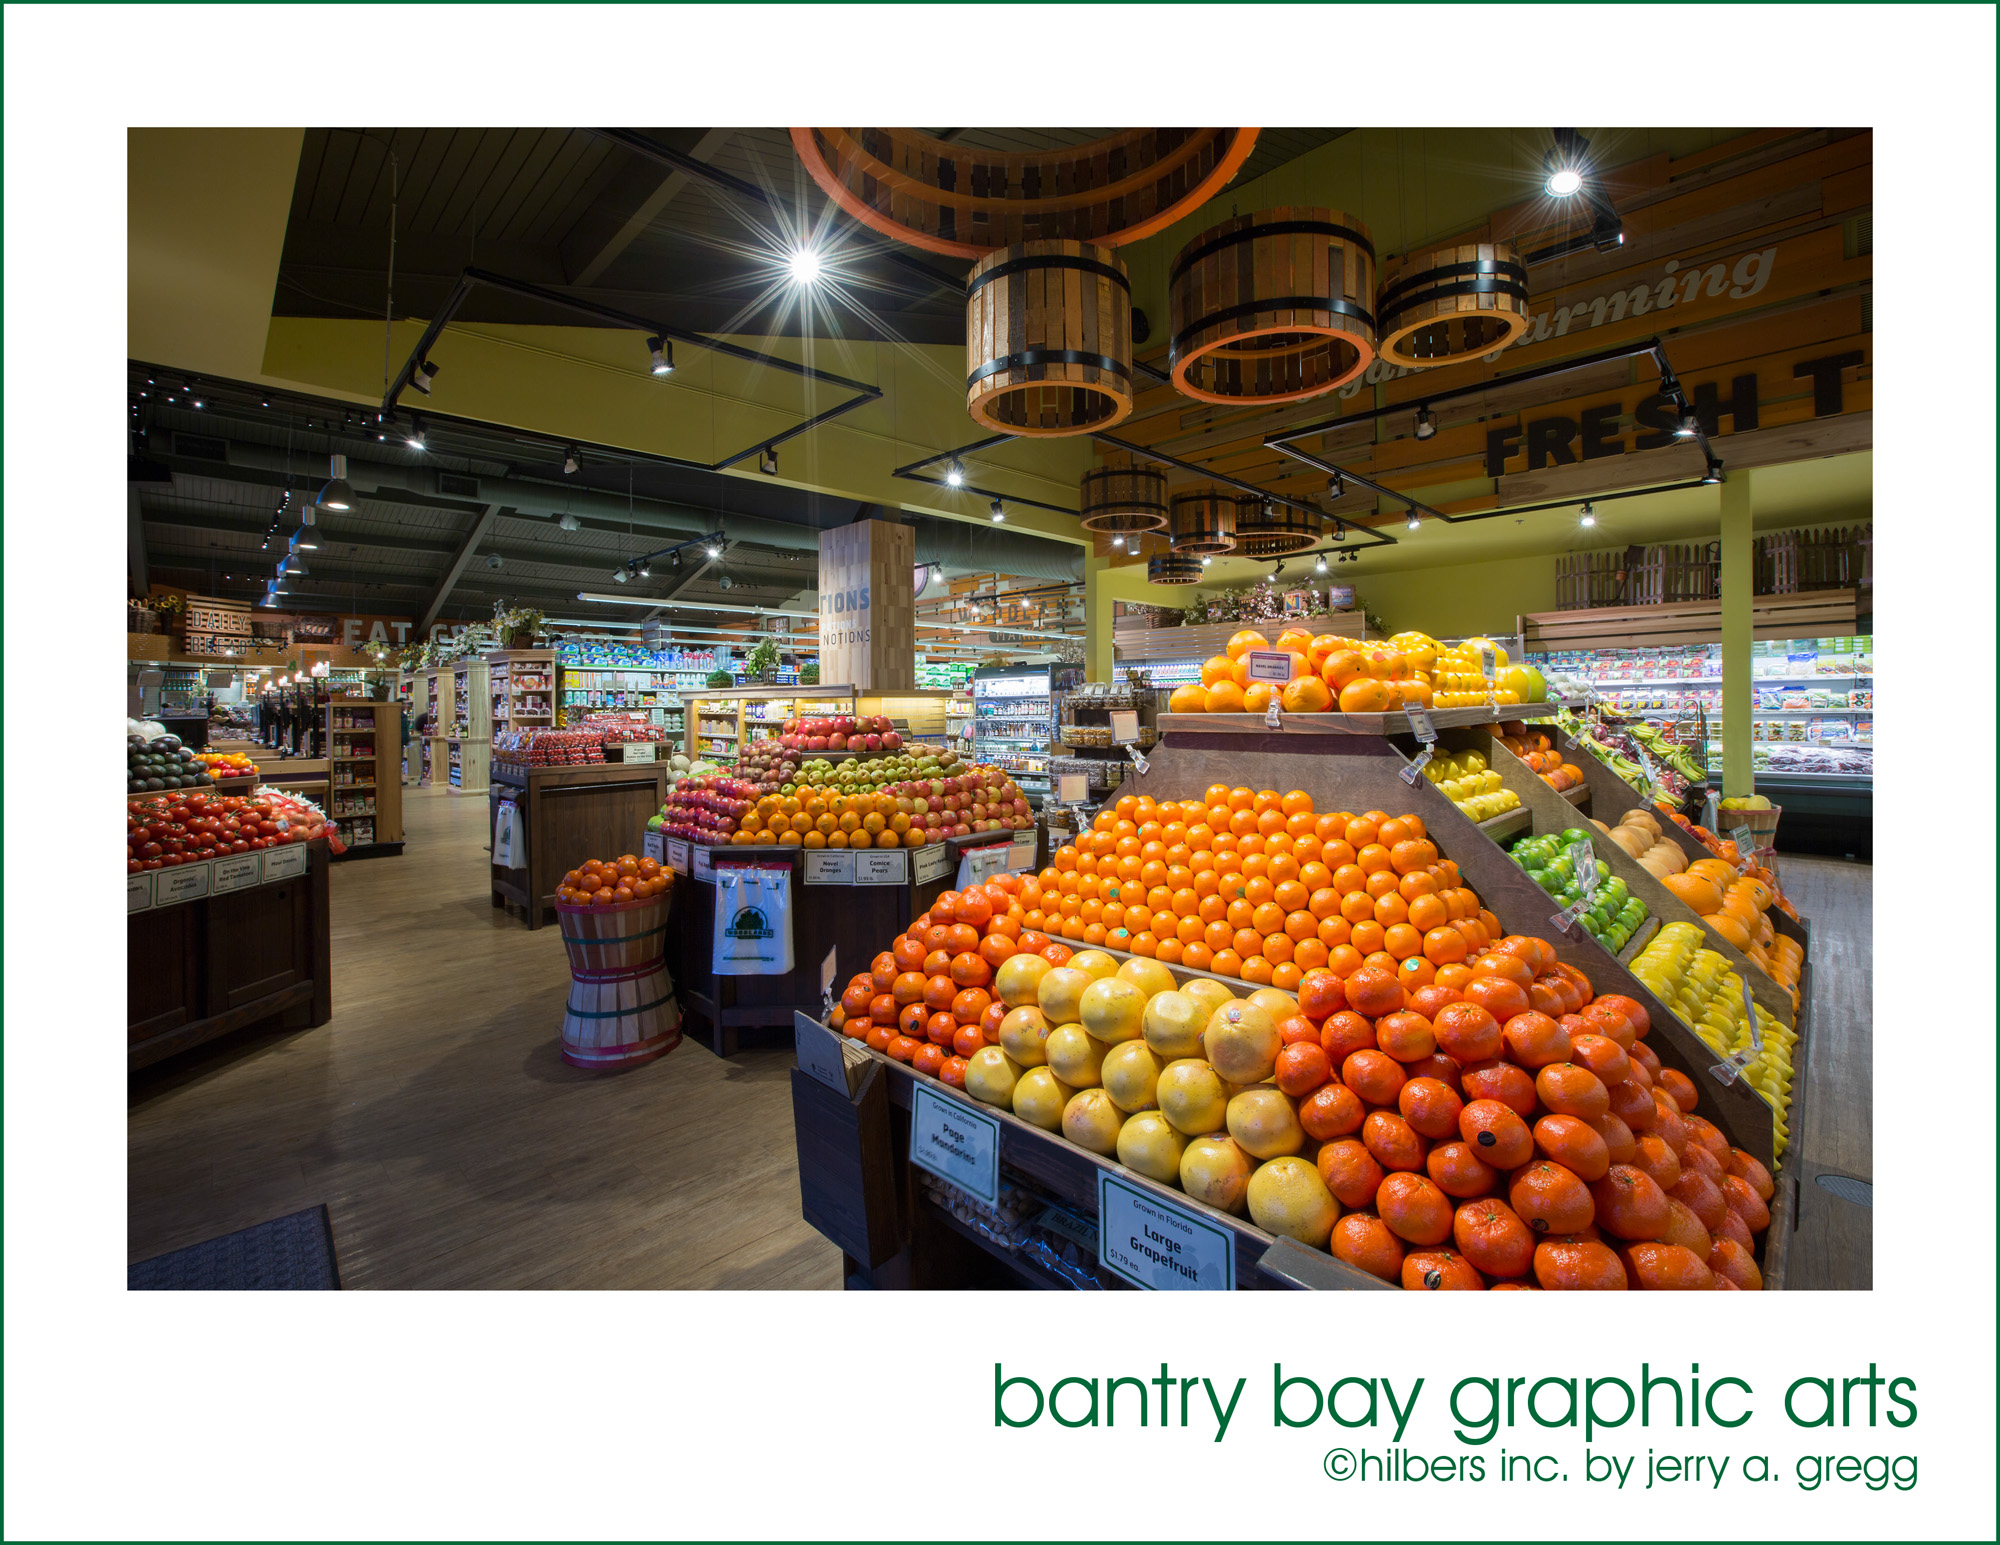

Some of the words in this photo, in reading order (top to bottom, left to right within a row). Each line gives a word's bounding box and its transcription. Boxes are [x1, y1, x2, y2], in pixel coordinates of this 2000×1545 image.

[1484, 247, 1777, 363] arming
[1487, 372, 1759, 478] FRESH
[192, 611, 247, 632] DAILY
[344, 619, 413, 646] EAT
[190, 636, 248, 656] BREAD
[823, 629, 871, 646] NOTIONS
[943, 1123, 965, 1144] Page
[931, 1133, 976, 1166] Mandarins
[1051, 1213, 1089, 1238] BRAZIL
[1133, 1200, 1157, 1218] Grown
[1157, 1210, 1165, 1221] in
[1166, 1216, 1193, 1236] Florida
[1144, 1224, 1182, 1254] Large
[1110, 1248, 1129, 1266] $1.79
[1129, 1259, 1141, 1273] ea.
[1130, 1236, 1198, 1283] Grapefruit
